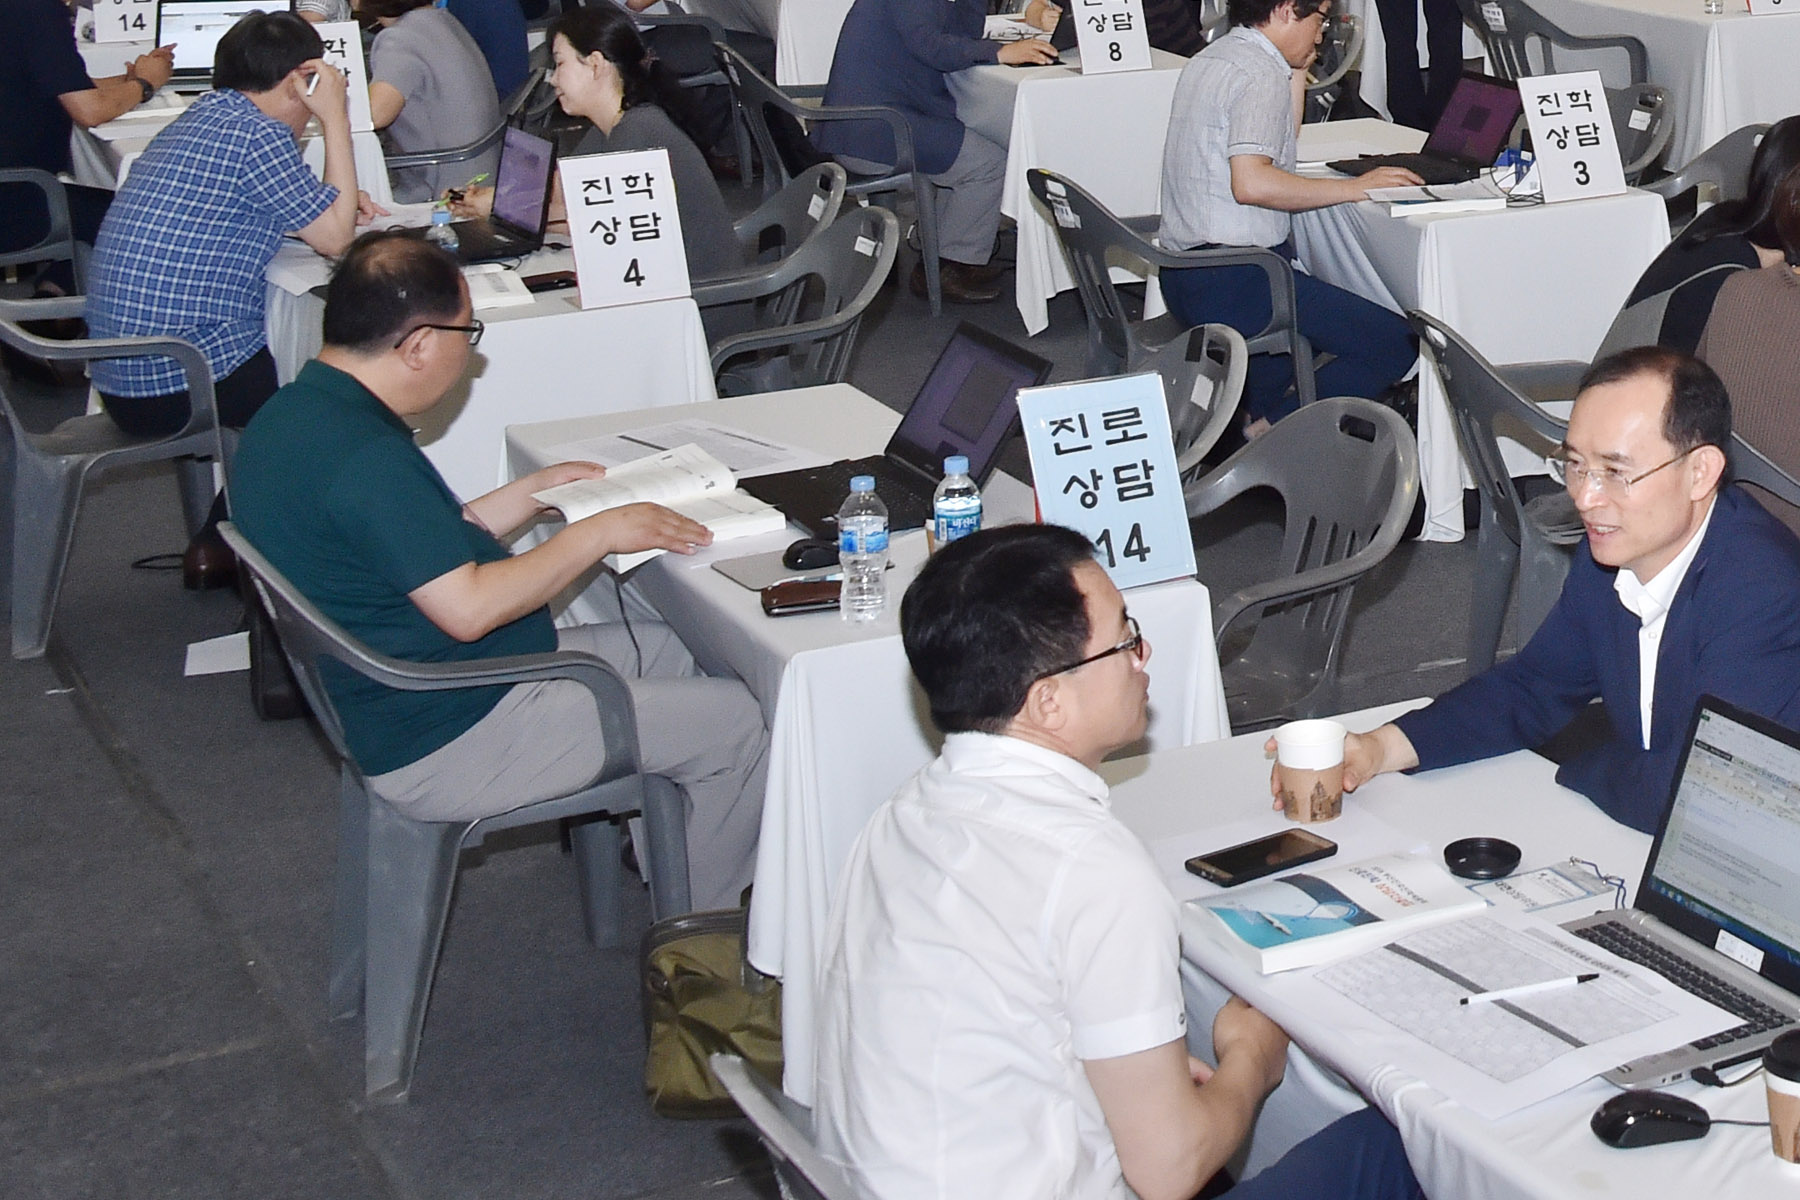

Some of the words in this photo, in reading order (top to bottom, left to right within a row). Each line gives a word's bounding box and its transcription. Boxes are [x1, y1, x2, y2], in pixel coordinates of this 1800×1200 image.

[118, 12, 147, 32] 14
[1087, 9, 1134, 34] 상담
[1108, 41, 1123, 62] 8
[1536, 89, 1593, 117] 진학
[1546, 122, 1601, 150] 상담
[1573, 160, 1591, 186] 3
[581, 171, 656, 206] 진학
[589, 213, 663, 246] 상담
[623, 257, 647, 288] 4
[1048, 405, 1149, 457] 진로
[1062, 457, 1155, 510] 상담
[1095, 521, 1152, 569] 14
